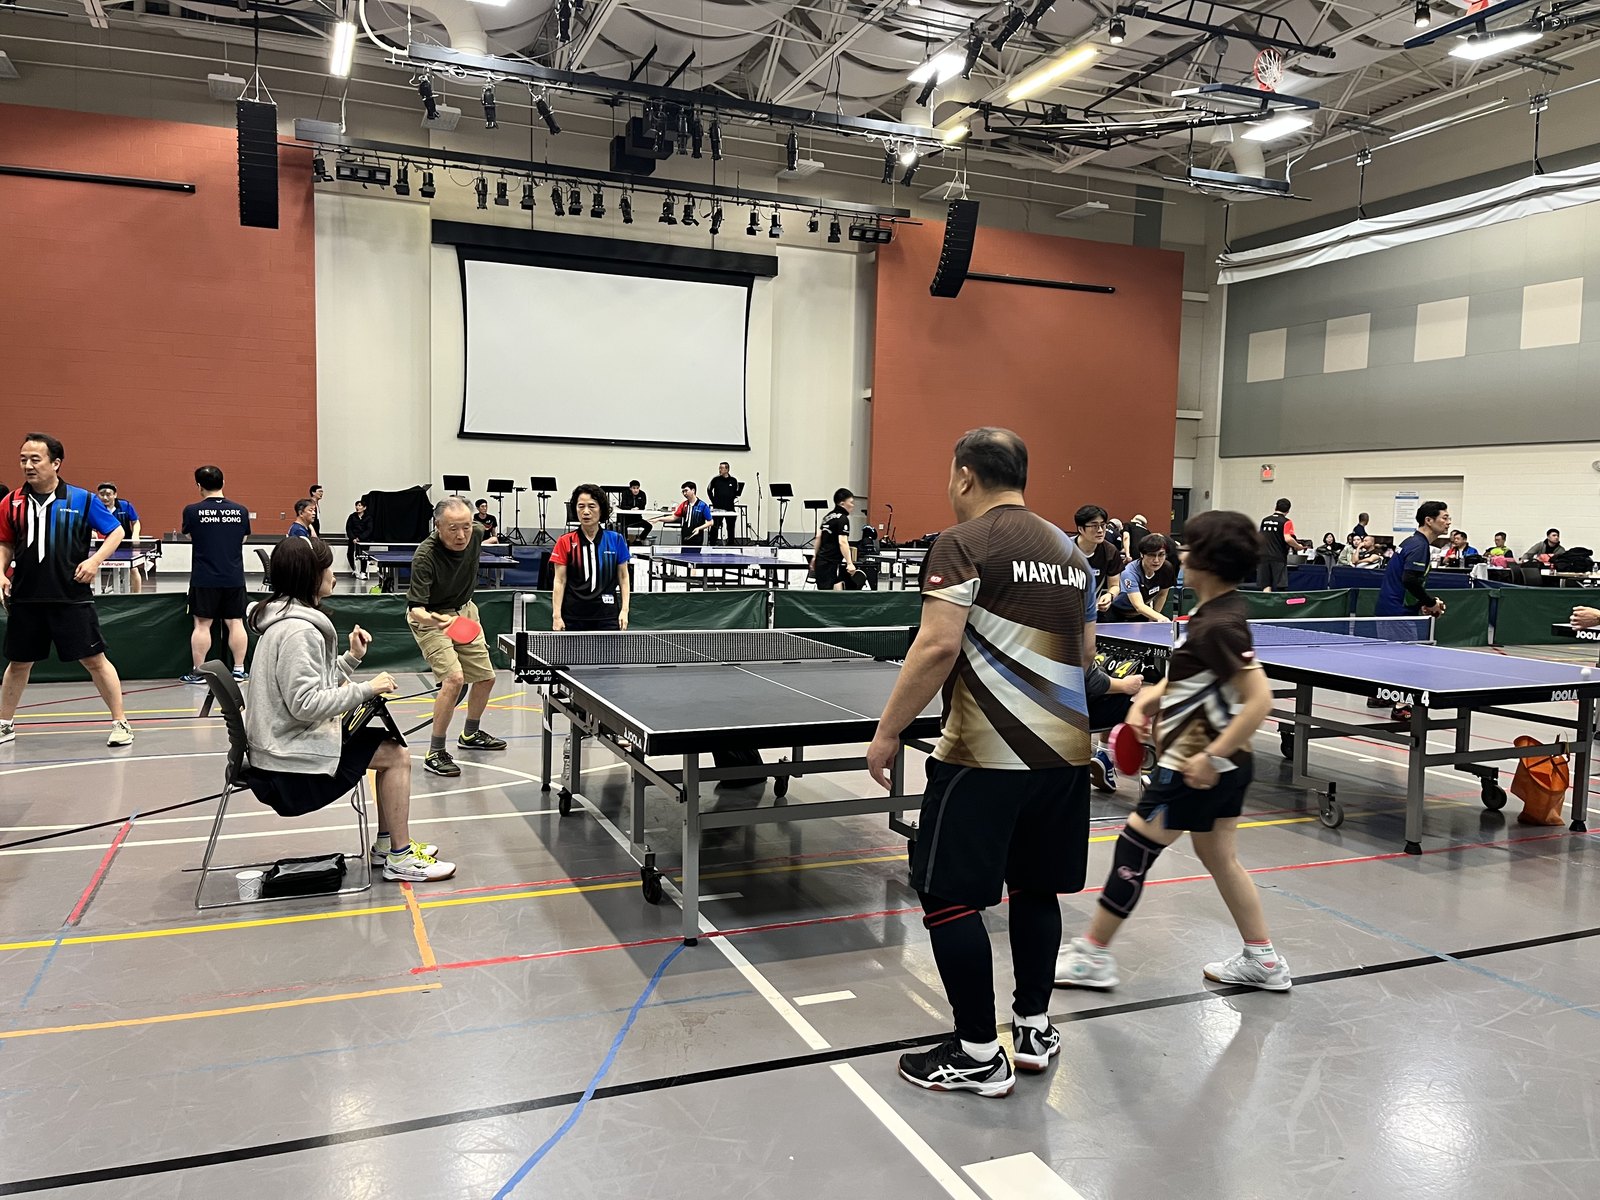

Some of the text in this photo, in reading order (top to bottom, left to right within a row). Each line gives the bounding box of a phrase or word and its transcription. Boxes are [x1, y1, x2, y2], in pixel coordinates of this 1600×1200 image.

[1114, 661, 1133, 678] 4
[1376, 687, 1430, 707] JOOLA 4
[1551, 689, 1578, 702] JOOLA
